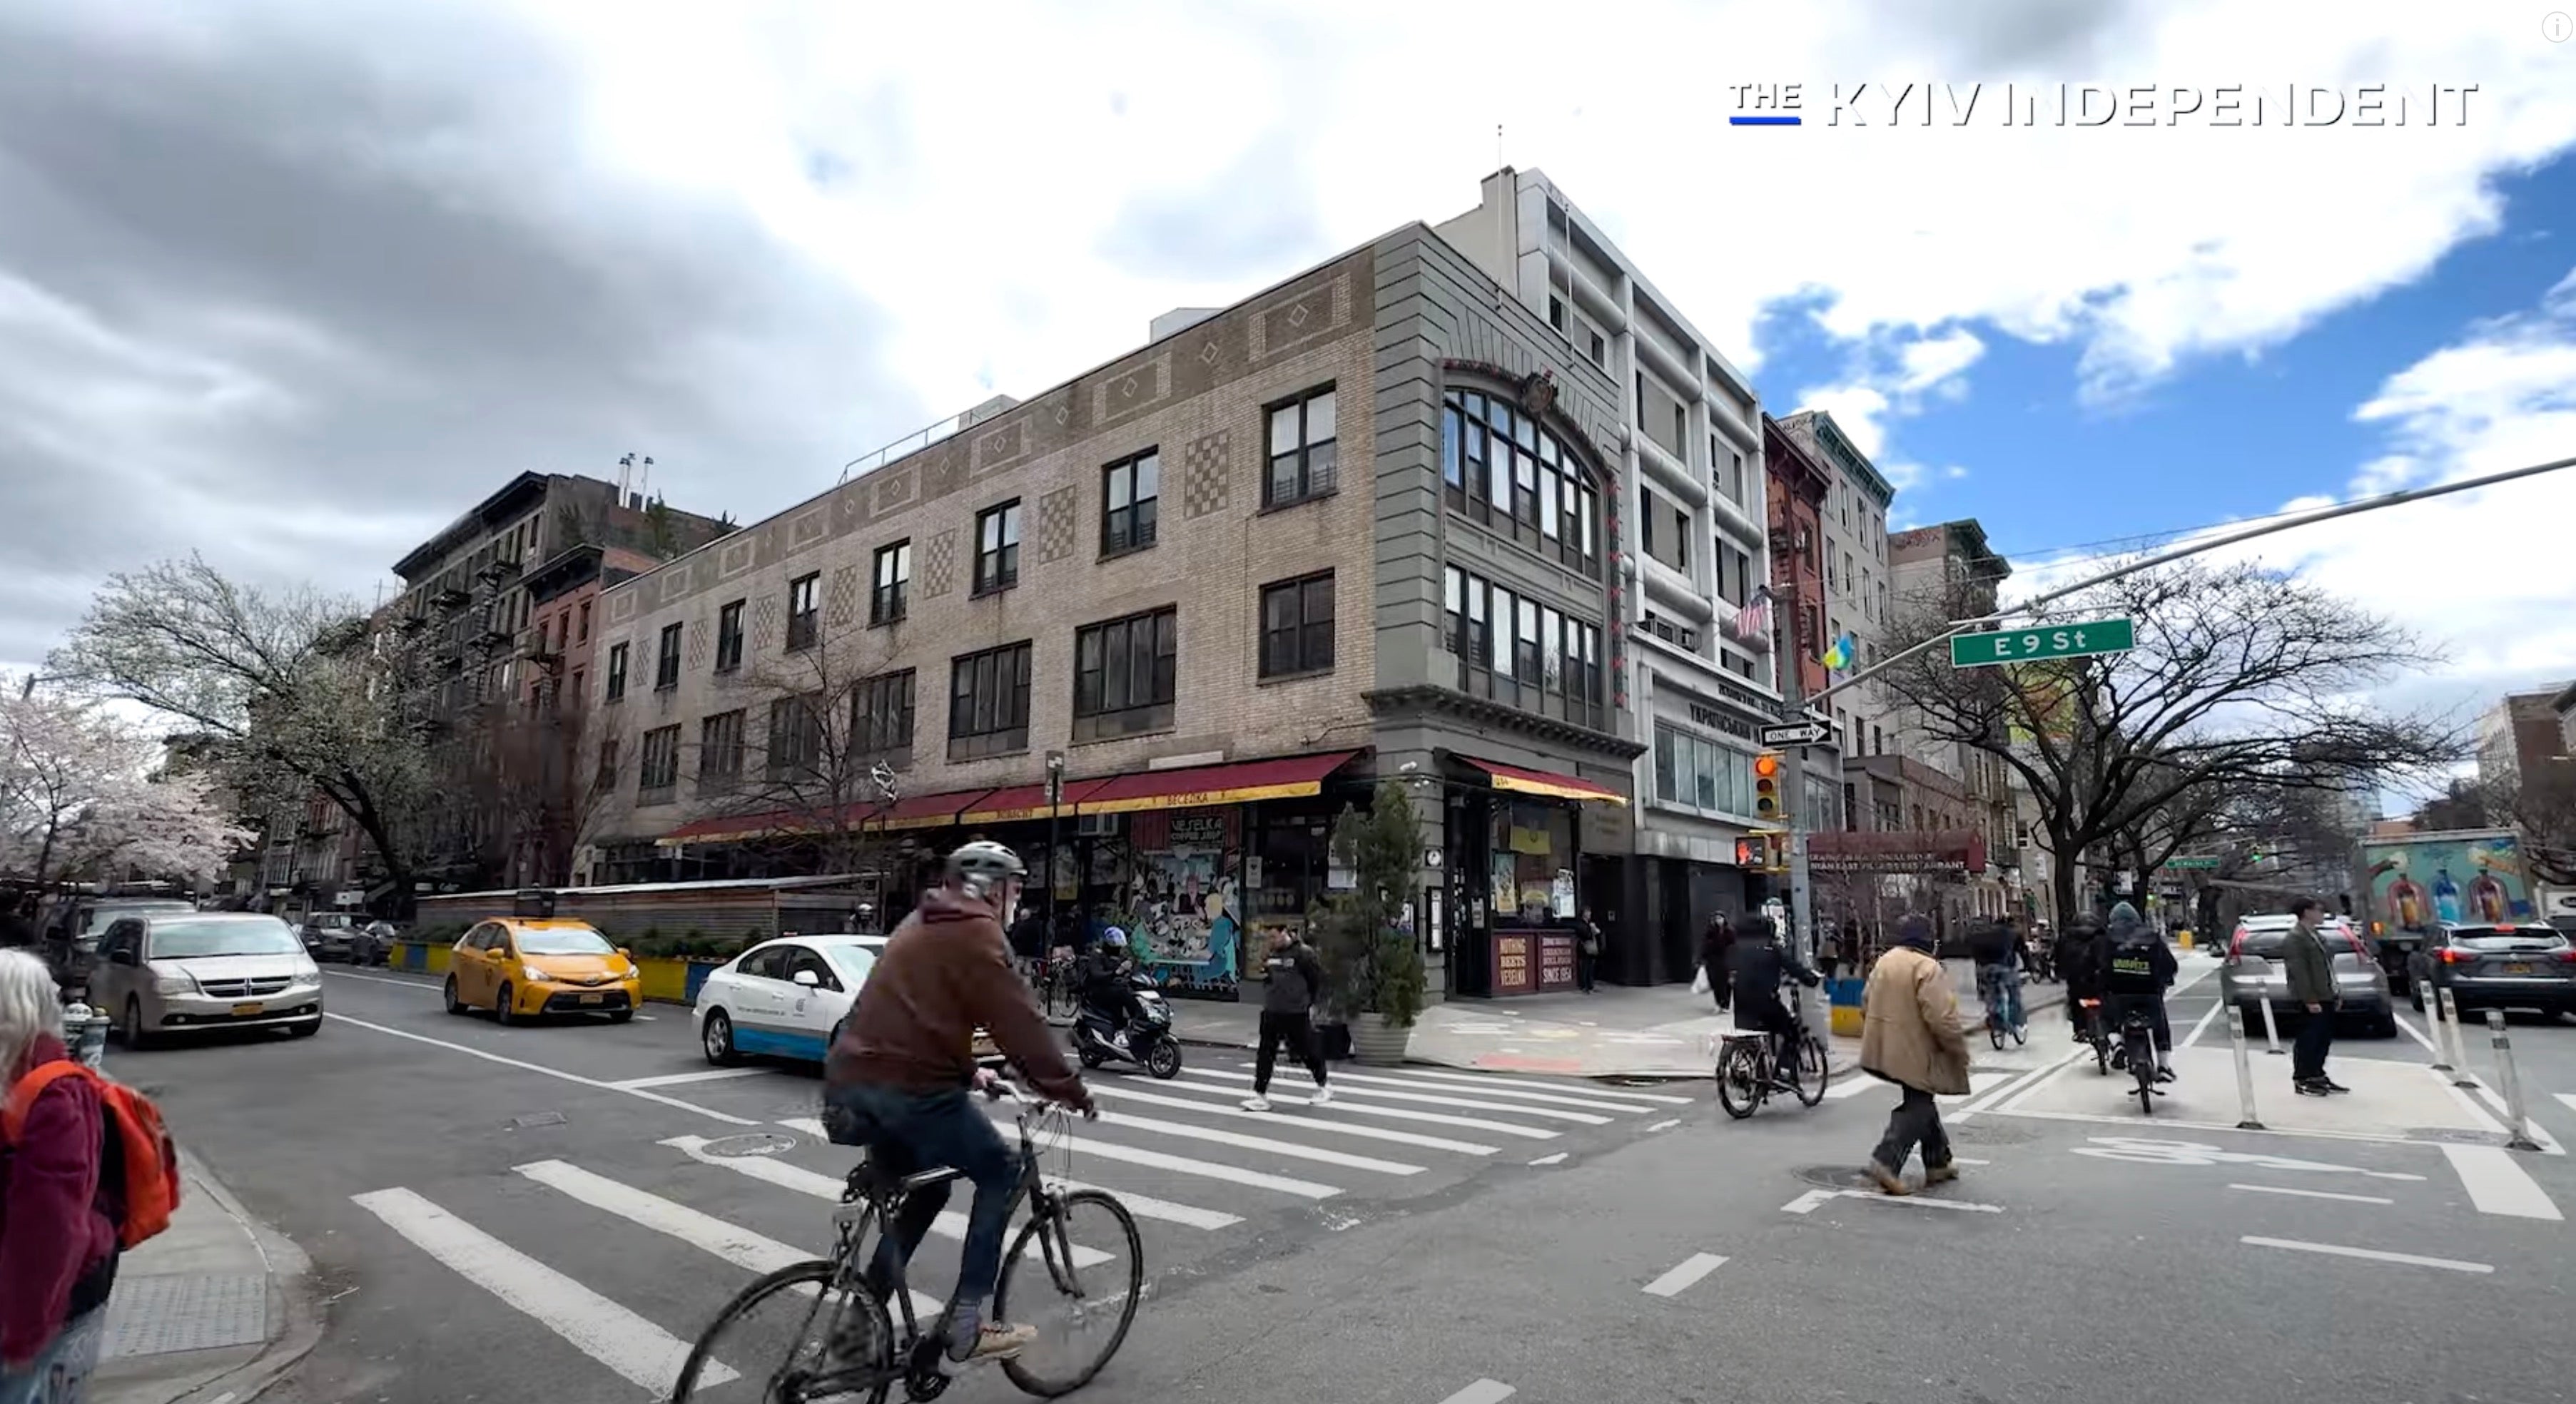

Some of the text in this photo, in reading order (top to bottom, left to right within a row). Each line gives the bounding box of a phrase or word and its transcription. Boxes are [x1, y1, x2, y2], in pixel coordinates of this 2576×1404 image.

[1994, 630, 2086, 657] E 9 St
[1770, 731, 1790, 741] ONE
[1799, 728, 1820, 738] WAY
[1499, 937, 1526, 955] NOTHING
[1500, 955, 1526, 967] BEETS
[1500, 968, 1526, 986] VESELKA
[1543, 967, 1560, 983] SINCE
